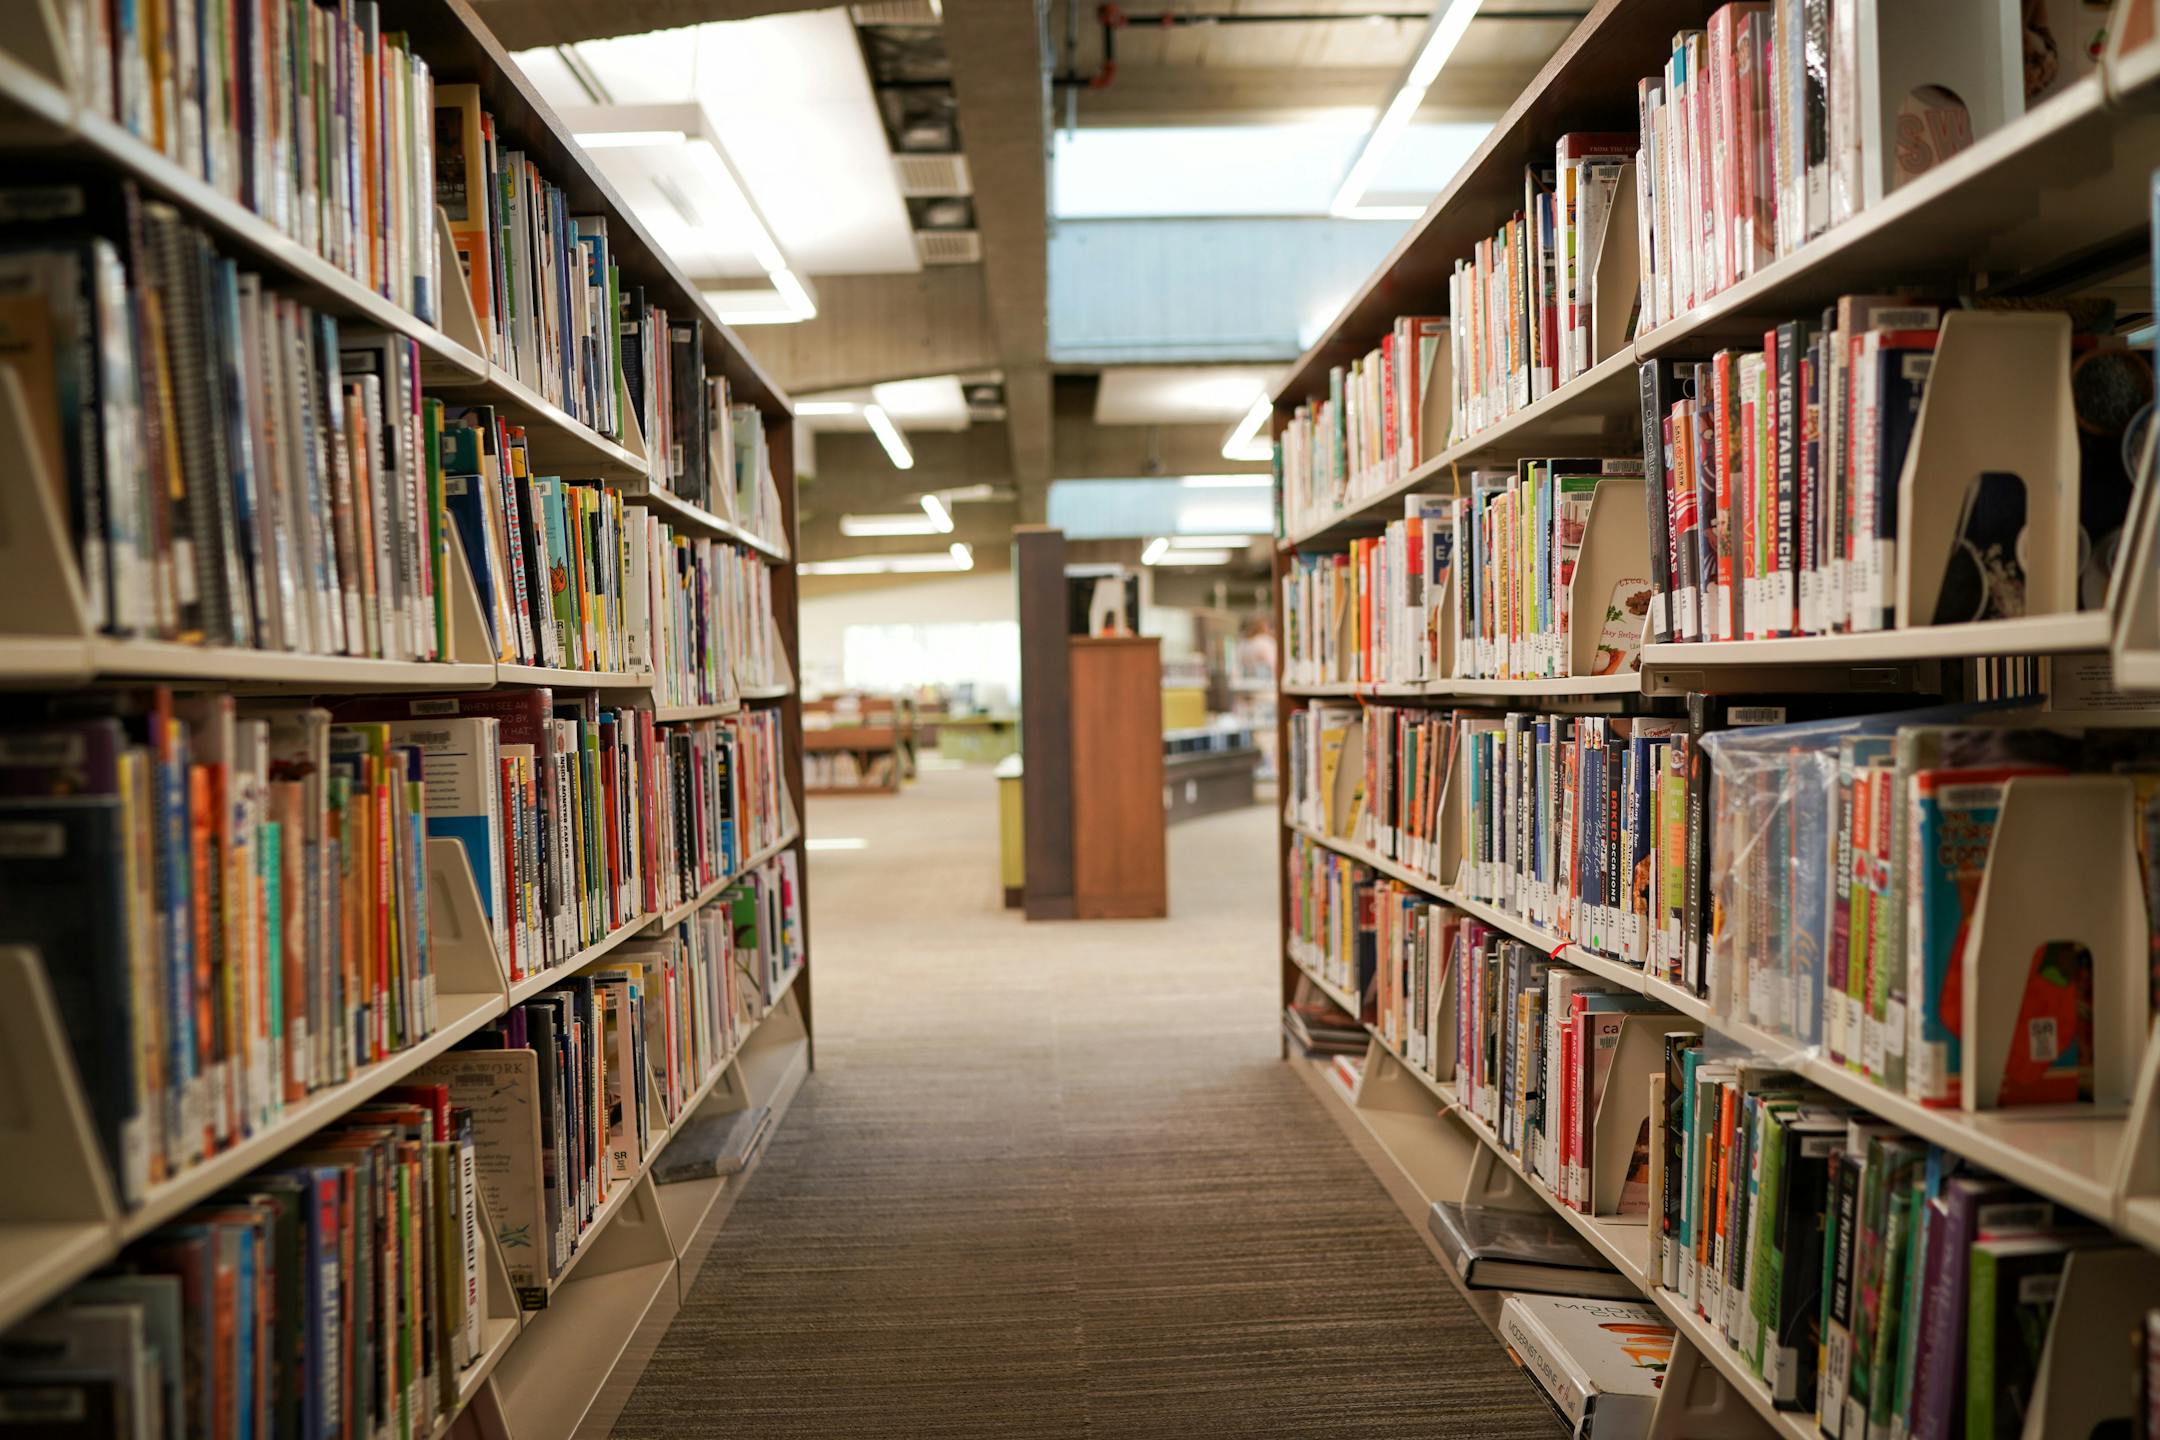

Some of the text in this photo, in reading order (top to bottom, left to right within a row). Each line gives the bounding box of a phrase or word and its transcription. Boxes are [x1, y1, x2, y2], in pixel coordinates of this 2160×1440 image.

[1778, 371, 1792, 493] VEGETABLE
[1666, 488, 1678, 573] PALETAS
[1766, 436, 1775, 555] COOKBOOK
[462, 703, 489, 712] WHEN
[497, 701, 513, 711] SEE
[515, 701, 528, 710] AN
[1689, 792, 1699, 907] professional
[475, 1062, 524, 1075] WORK
[1571, 1062, 1577, 1073] IN
[614, 1151, 627, 1160] SR
[1834, 1194, 1853, 1319] THE PLANTIFUL TABLE
[1508, 1320, 1538, 1360] MODERNIST
[1536, 1354, 1558, 1386] CUISINE
